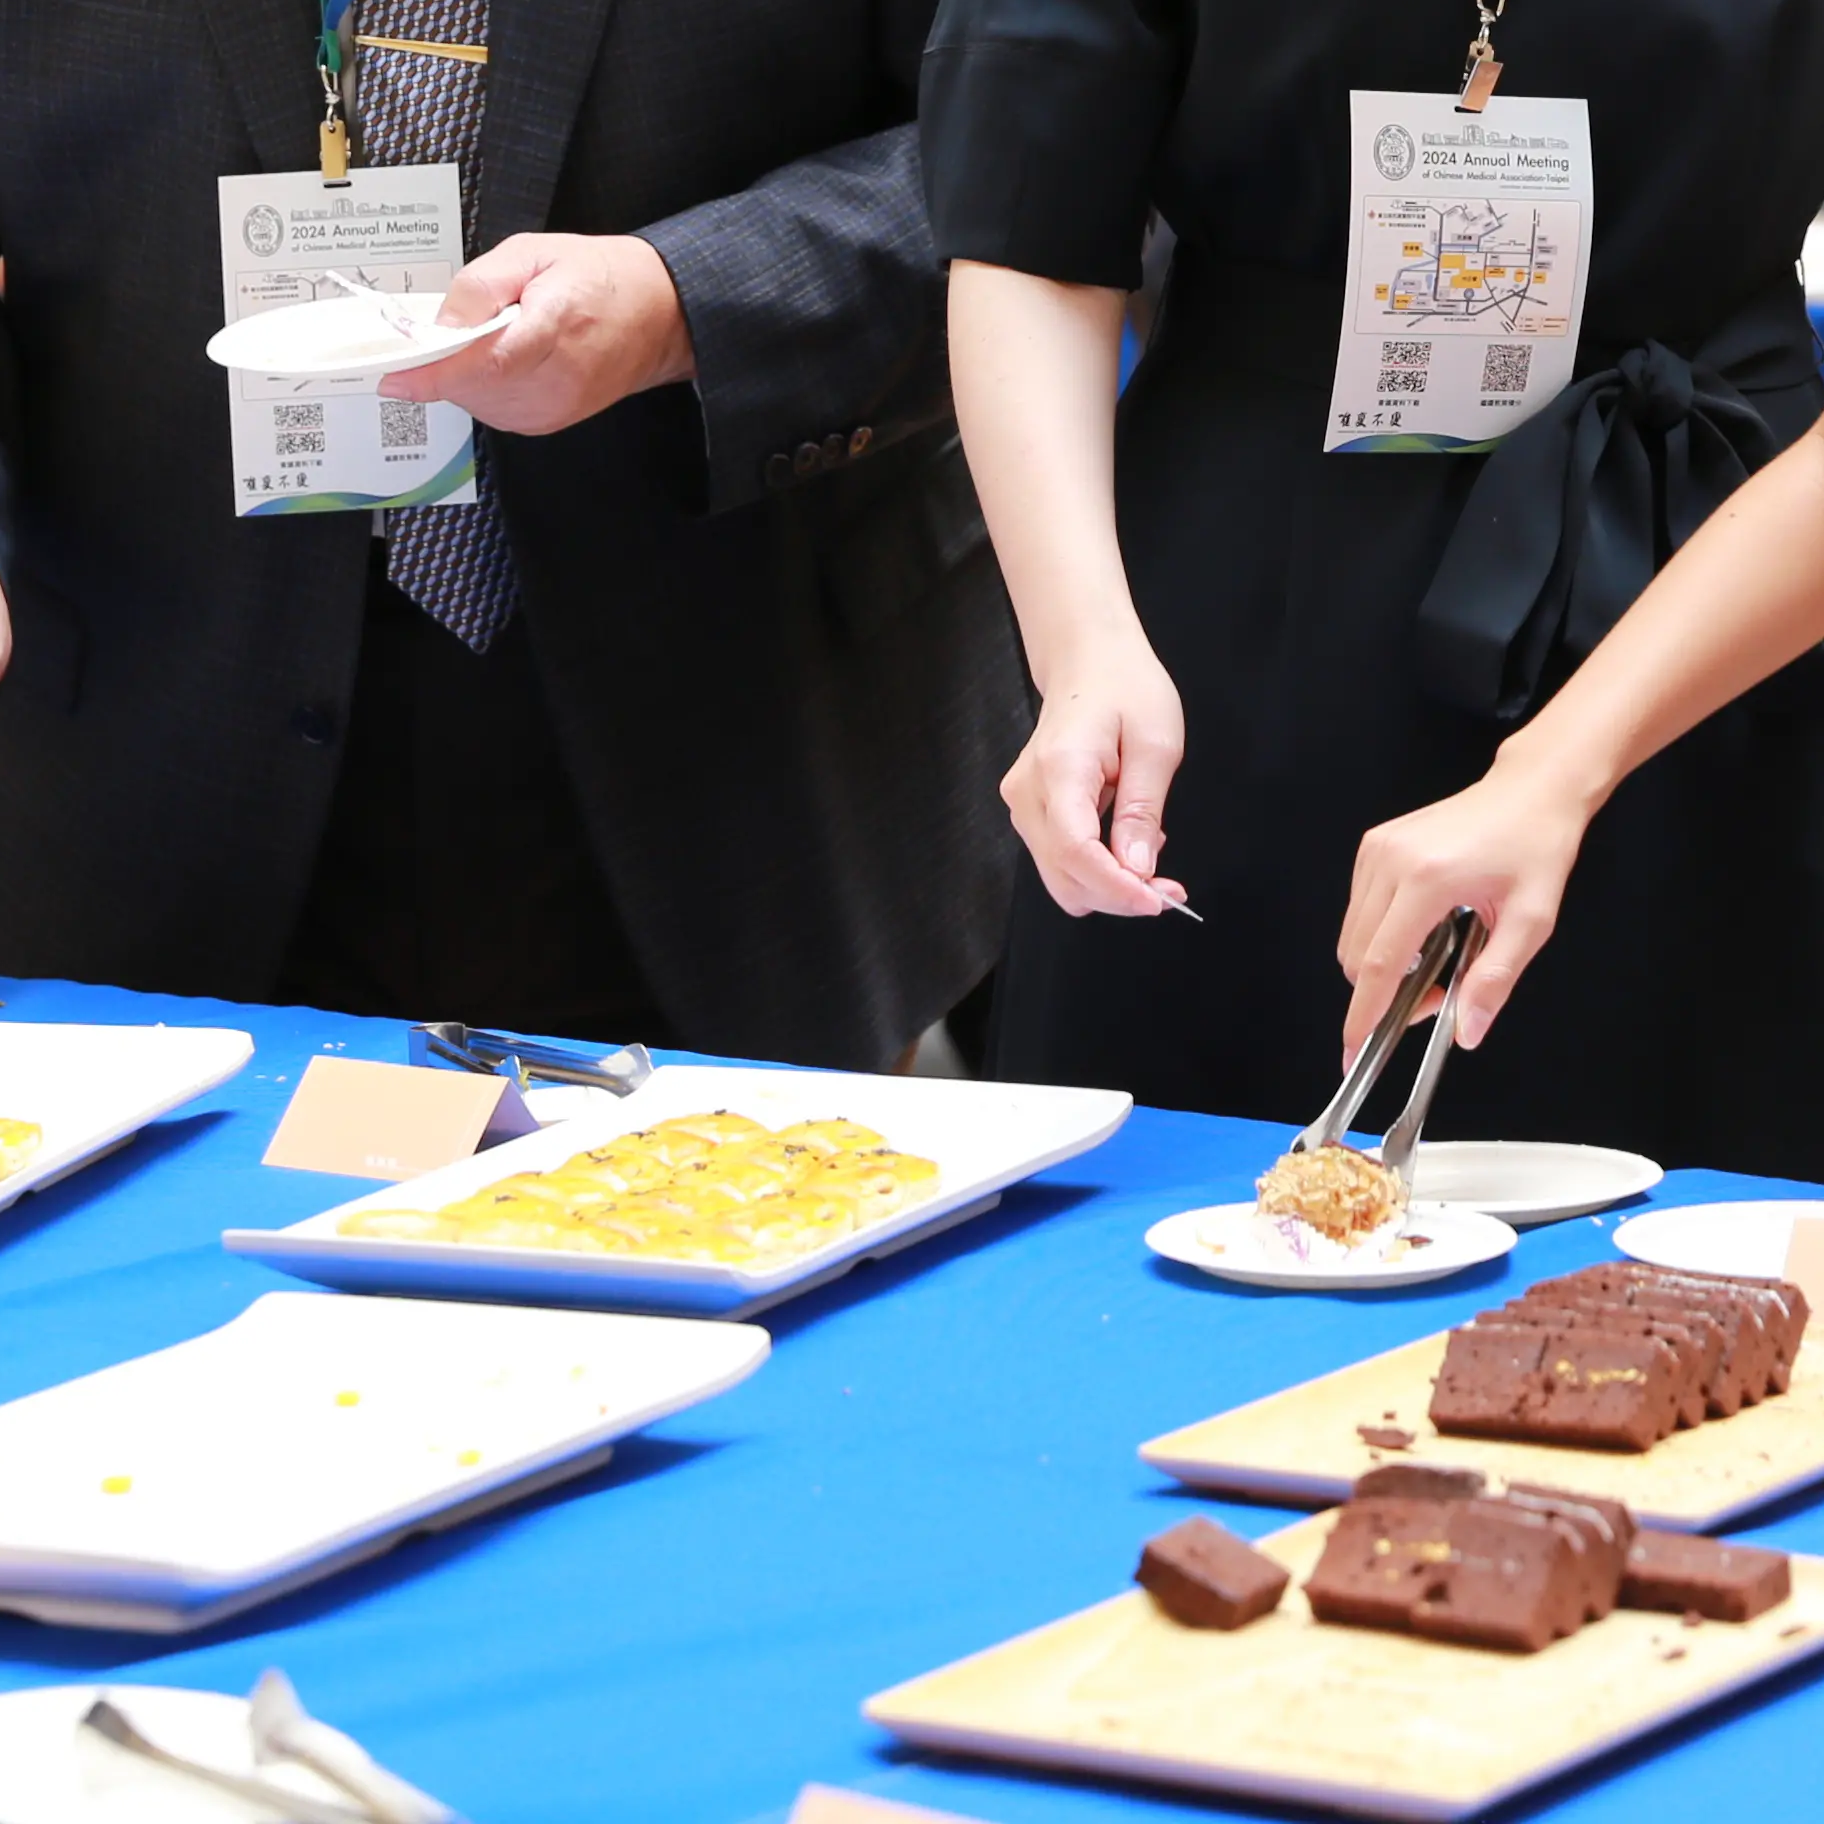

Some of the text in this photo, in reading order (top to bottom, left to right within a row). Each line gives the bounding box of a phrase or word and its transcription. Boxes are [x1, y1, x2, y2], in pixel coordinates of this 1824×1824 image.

[1422, 151, 1570, 172] 2024 Annual Meeting
[1422, 170, 1430, 179] of
[1433, 171, 1464, 180] Chinese
[1466, 172, 1497, 181] Medical
[292, 220, 440, 240] 2024 Annual Meeting
